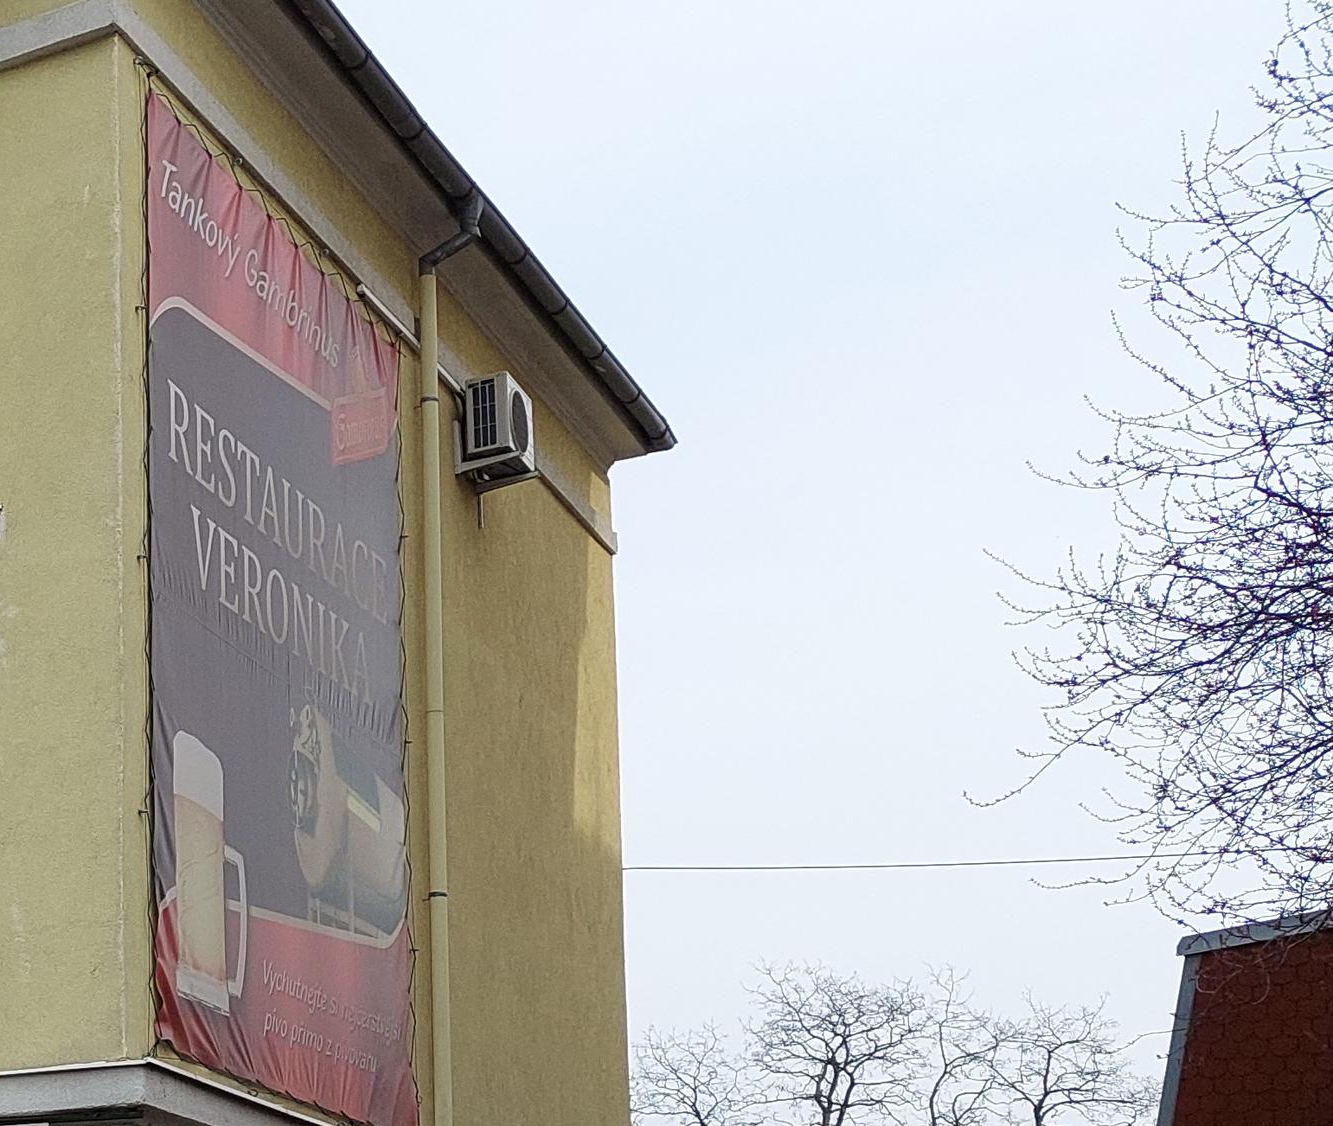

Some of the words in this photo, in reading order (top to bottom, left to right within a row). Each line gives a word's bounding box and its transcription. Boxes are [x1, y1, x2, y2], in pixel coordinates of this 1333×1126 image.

[160, 160, 240, 278] Tankový
[244, 248, 341, 369] Gambrinus
[166, 377, 388, 627] RESTAURACE
[189, 503, 373, 705] VERONIKA
[262, 959, 328, 1014] Vychutnejte
[263, 1007, 288, 1037] pivo
[325, 1039, 332, 1056] z
